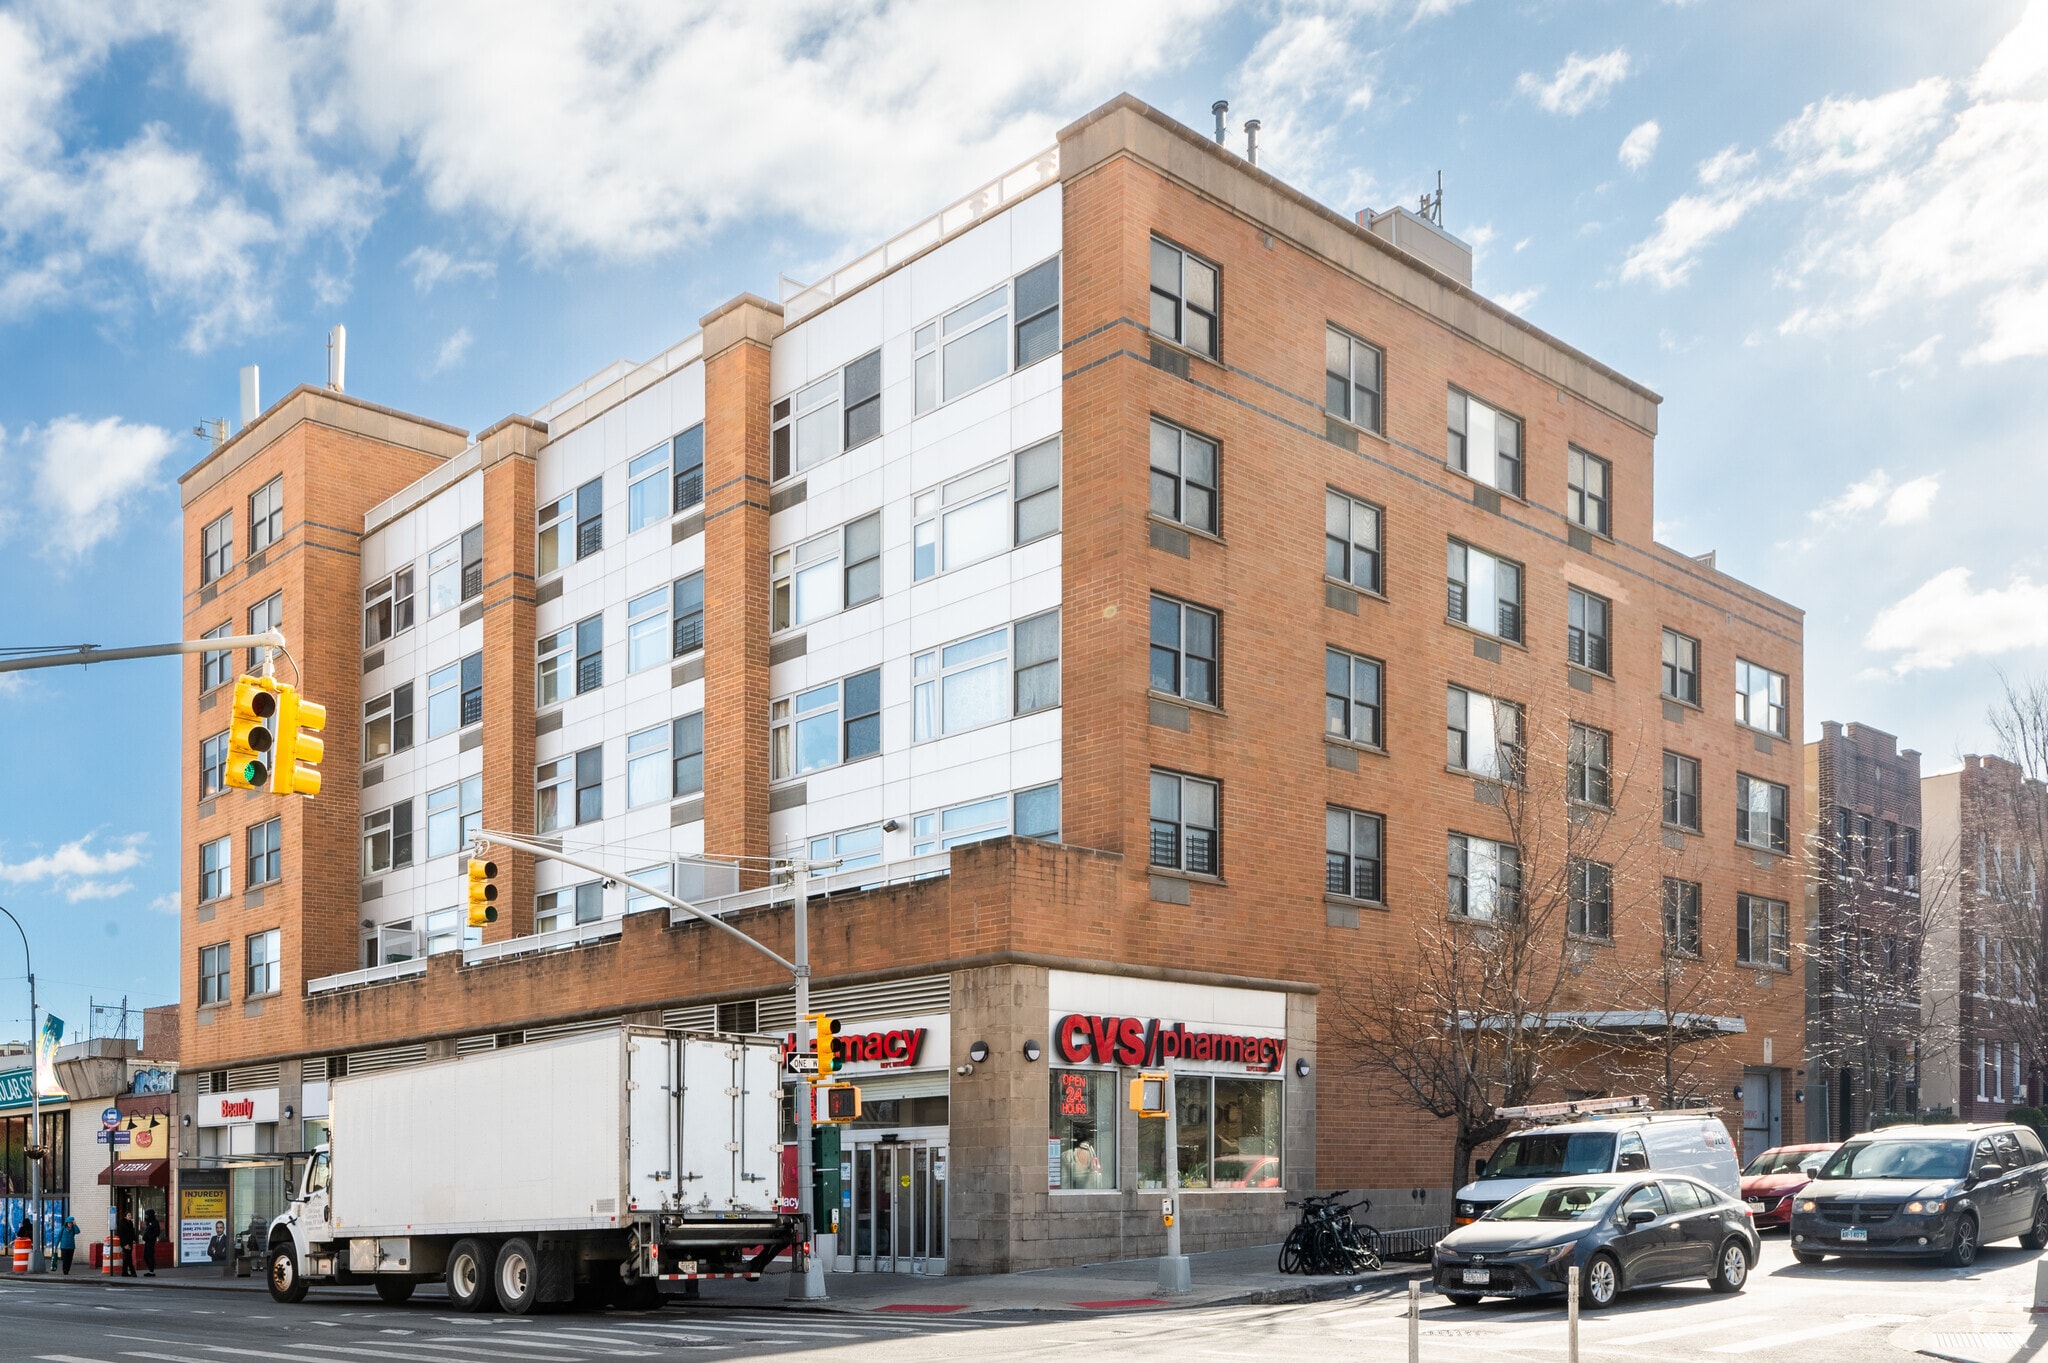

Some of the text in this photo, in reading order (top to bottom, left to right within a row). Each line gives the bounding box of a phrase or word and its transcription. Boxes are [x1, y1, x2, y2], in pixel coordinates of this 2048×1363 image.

[794, 1057, 807, 1068] ONE
[1062, 1073, 1086, 1088] OPEN
[1065, 1086, 1083, 1103] 24
[221, 1098, 254, 1120] Beauty
[1061, 1102, 1087, 1115] HOURS
[113, 1162, 153, 1172] PIZZERIA
[184, 1190, 224, 1198] INJURED?
[783, 1197, 799, 1210] acy
